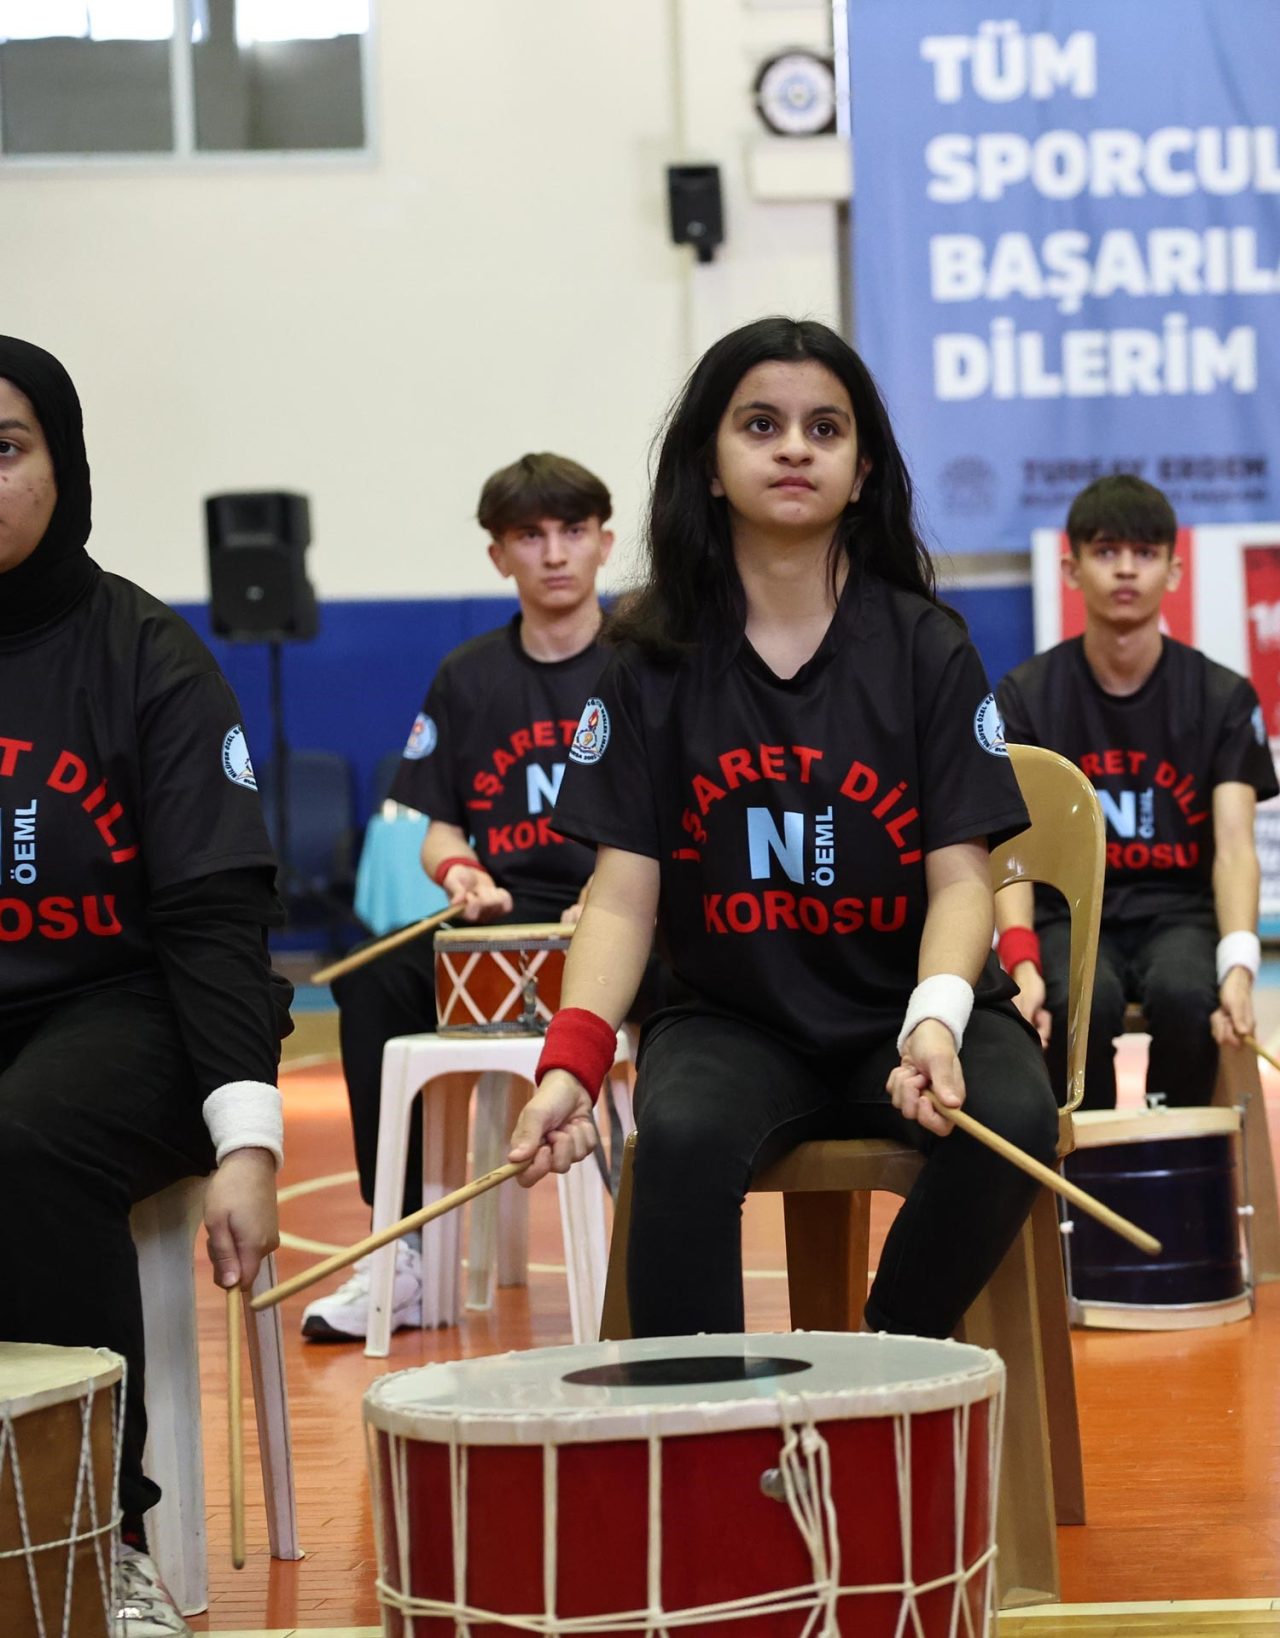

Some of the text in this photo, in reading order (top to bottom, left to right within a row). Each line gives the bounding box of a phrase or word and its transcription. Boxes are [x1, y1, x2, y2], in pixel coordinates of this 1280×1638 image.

[920, 20, 1097, 102] TÜM
[934, 313, 1257, 399] DİLERİM
[1079, 748, 1149, 779] RET
[526, 763, 567, 815] N
[672, 743, 923, 866] İŞARET DİLİ
[1095, 789, 1137, 838] N
[10, 799, 37, 885] ÖEML
[487, 815, 566, 856] KOR
[746, 805, 835, 887] N ÖEML
[1105, 841, 1199, 870] ROSU
[0, 894, 123, 942] OSU
[703, 889, 909, 937] KOROSU
